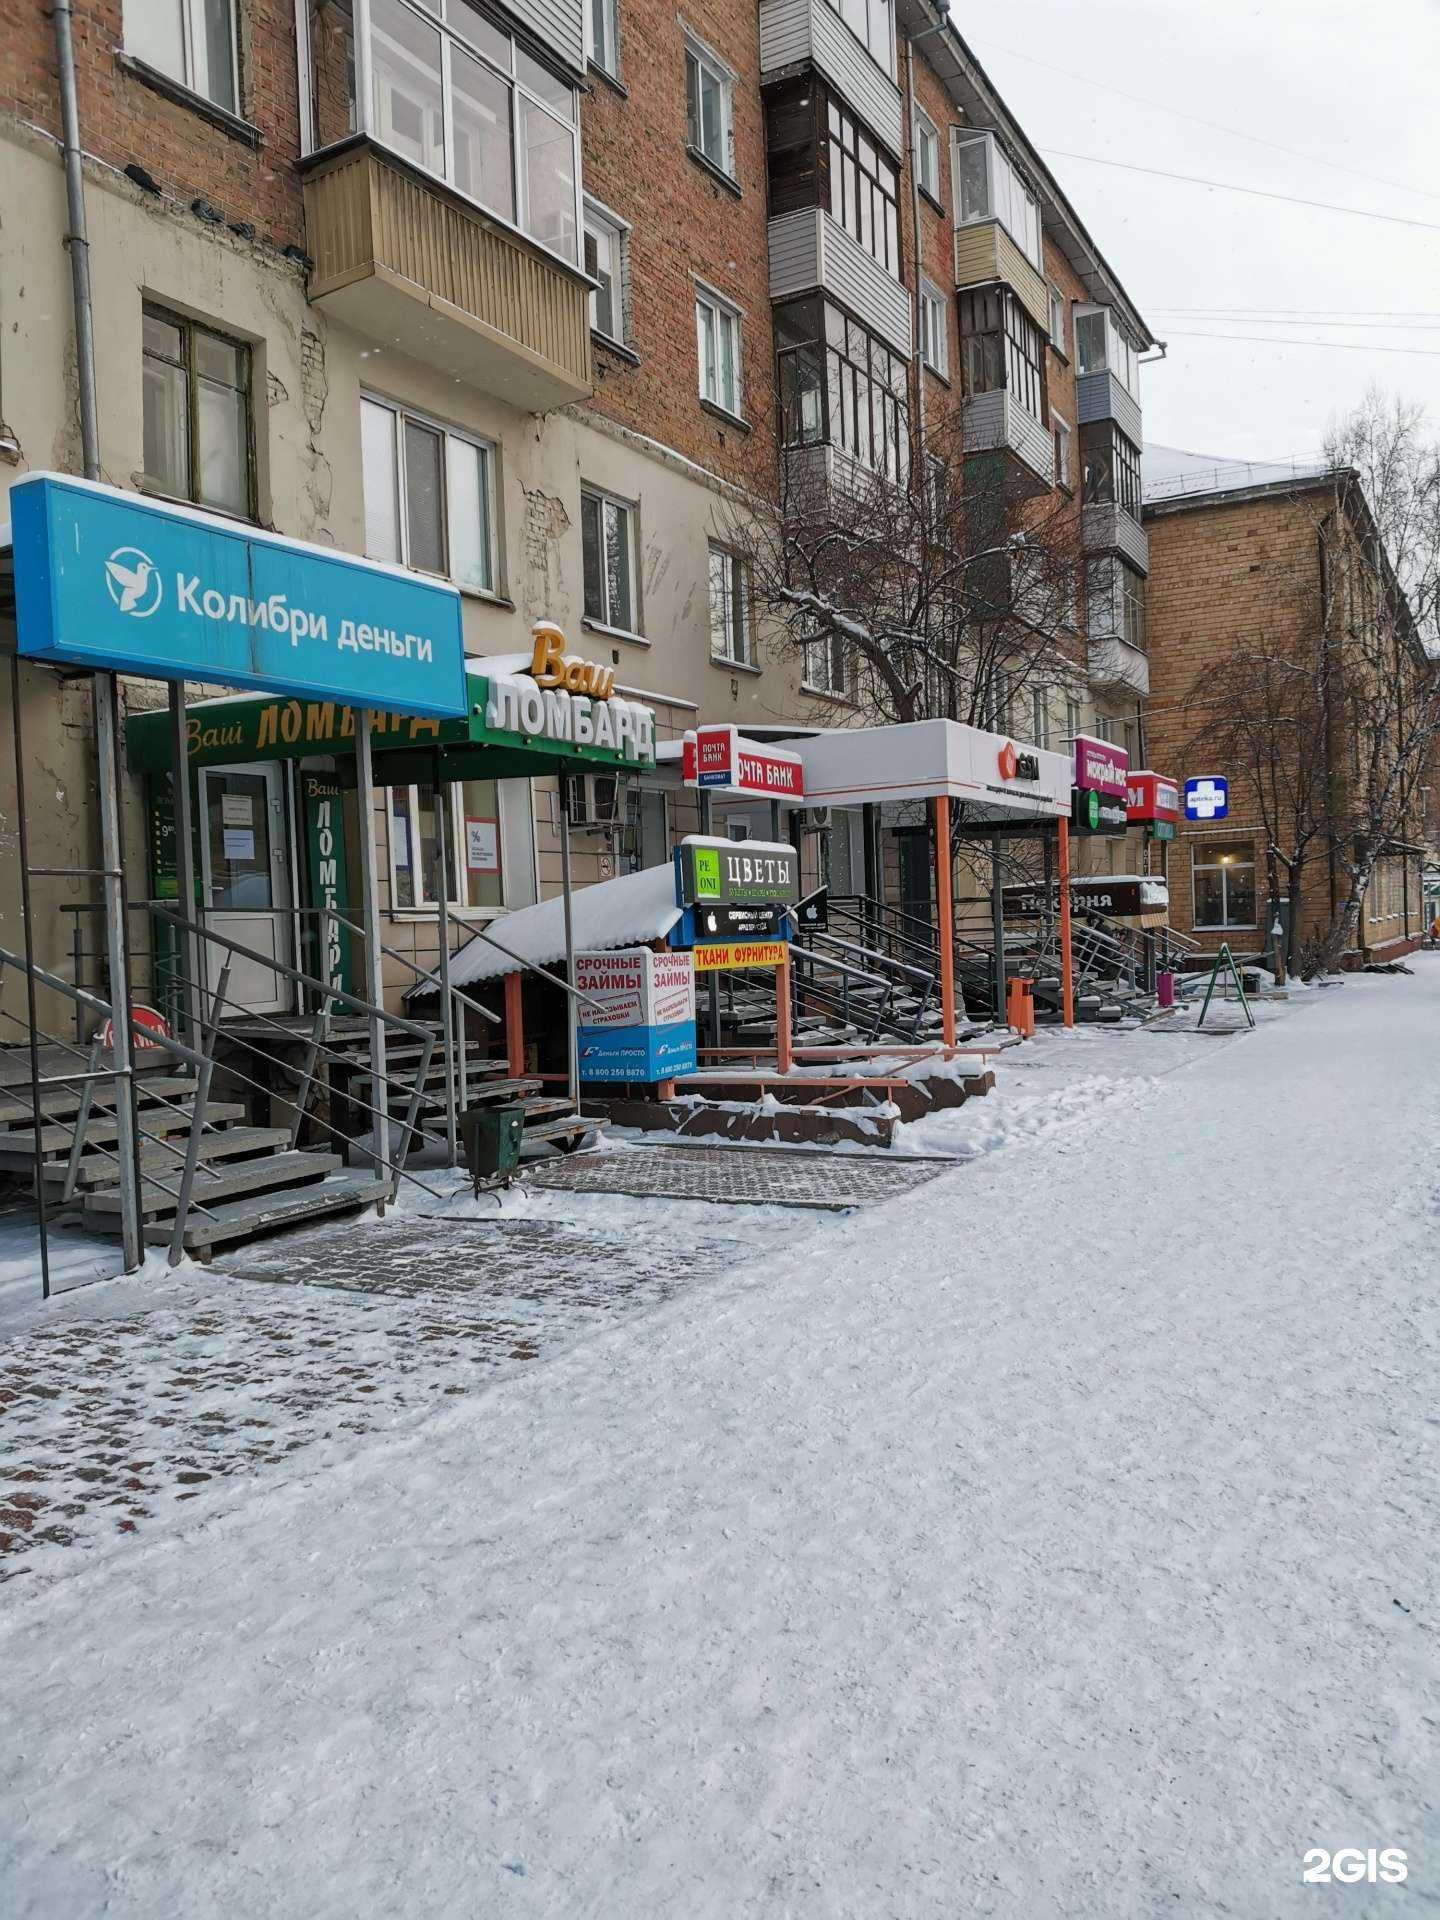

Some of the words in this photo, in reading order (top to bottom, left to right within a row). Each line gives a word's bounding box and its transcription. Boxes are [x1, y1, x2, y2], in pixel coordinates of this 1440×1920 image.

[176, 572, 328, 647] Колибри
[337, 619, 433, 663] деньги
[531, 622, 616, 701] Ваш
[486, 674, 657, 765] ЛОМБАРД
[184, 718, 244, 756] Ваш
[702, 743, 725, 753] ПОЧТА
[703, 753, 722, 763] БАНК
[738, 757, 764, 784] ОЧТА
[766, 763, 794, 788] БАНК
[305, 778, 339, 796] Ваш
[699, 859, 711, 872] PE
[726, 856, 791, 887] ЦВЕТЫ
[700, 878, 716, 890] ONI
[576, 957, 641, 970] СРОЧНЫЕ
[653, 954, 690, 968] СРОЧНЫЕ
[696, 947, 729, 968] ТКАНИ
[734, 945, 784, 963] ФУРНИТУРА
[577, 970, 641, 991] ЗАЙМЫ
[654, 968, 690, 988] ЗАЙМЫ
[592, 1001, 637, 1016] НАЗЫВАЕМ
[592, 1011, 630, 1025] СТРАХОВКИ
[621, 1048, 646, 1057] ПРОСТО
